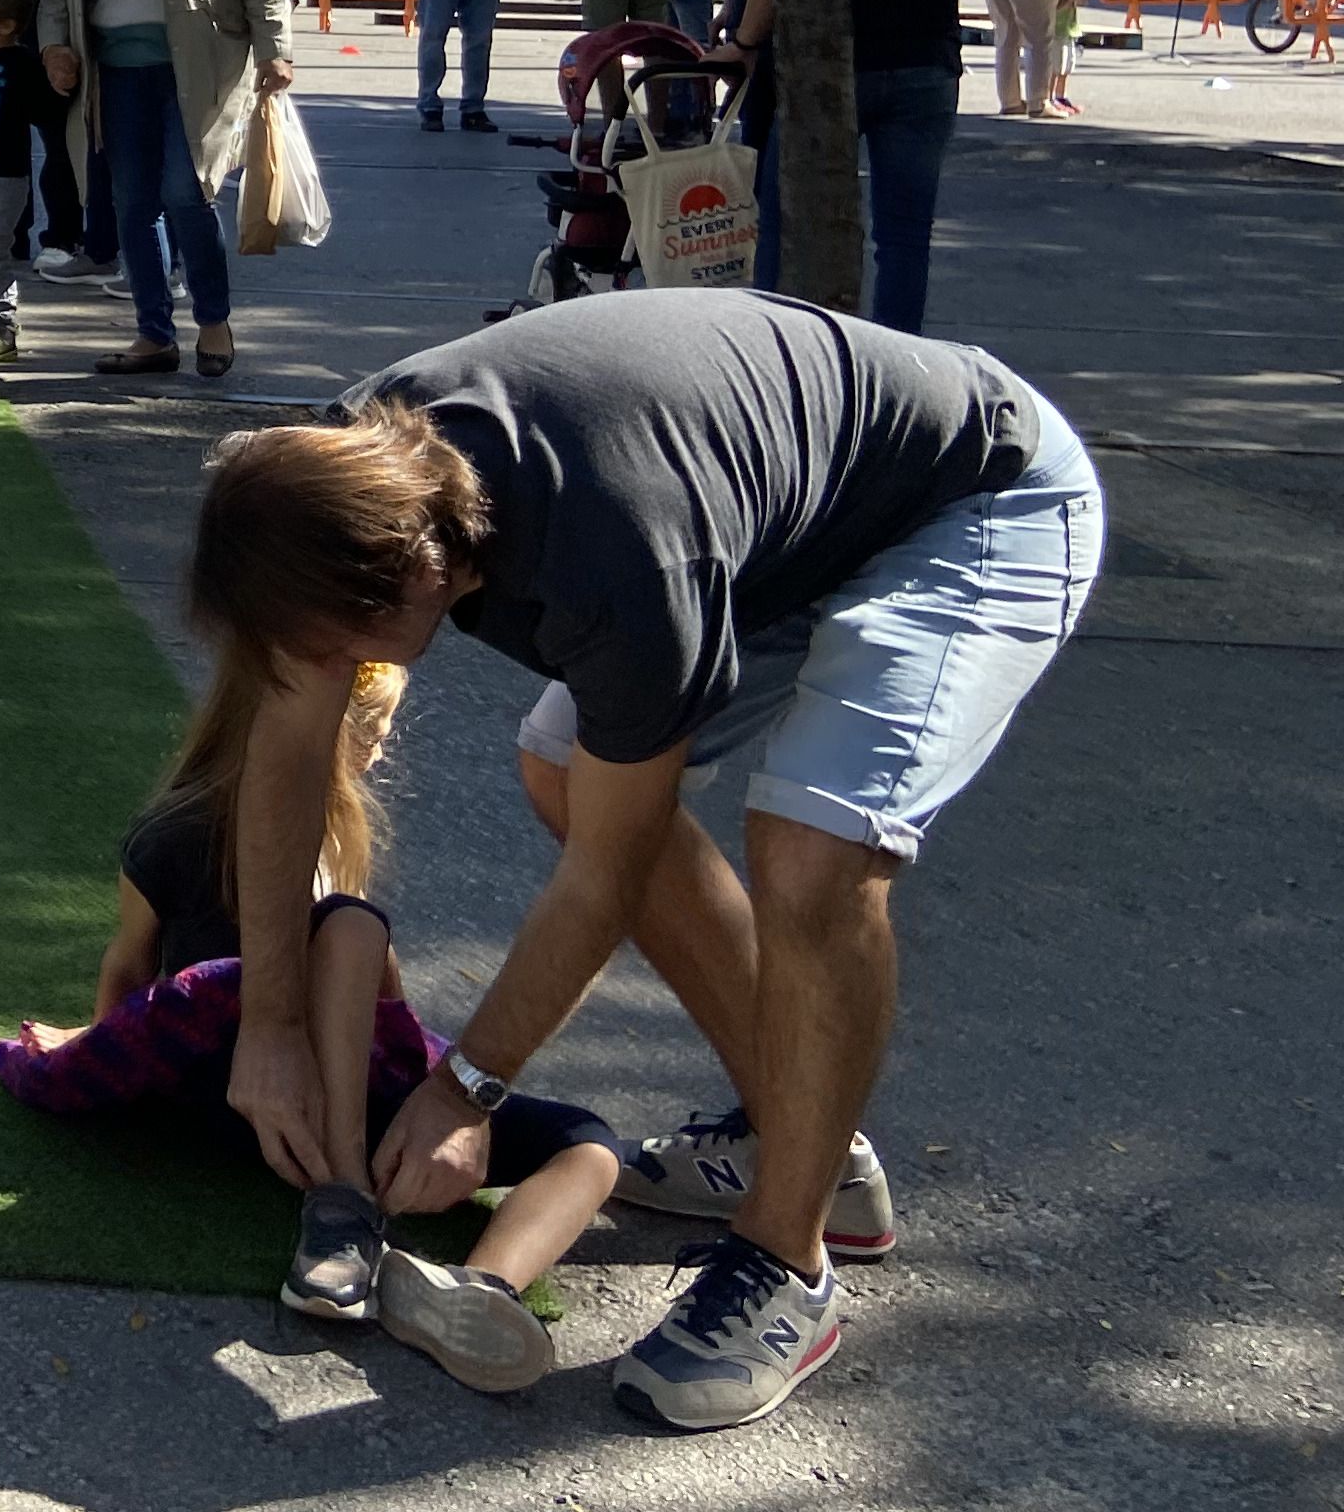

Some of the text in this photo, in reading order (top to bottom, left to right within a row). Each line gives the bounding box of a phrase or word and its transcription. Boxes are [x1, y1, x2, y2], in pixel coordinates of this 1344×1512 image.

[663, 224, 757, 261] Summer
[681, 217, 735, 239] EVERY
[691, 257, 746, 280] STORY
[695, 1155, 747, 1194] N
[759, 1315, 802, 1361] N
